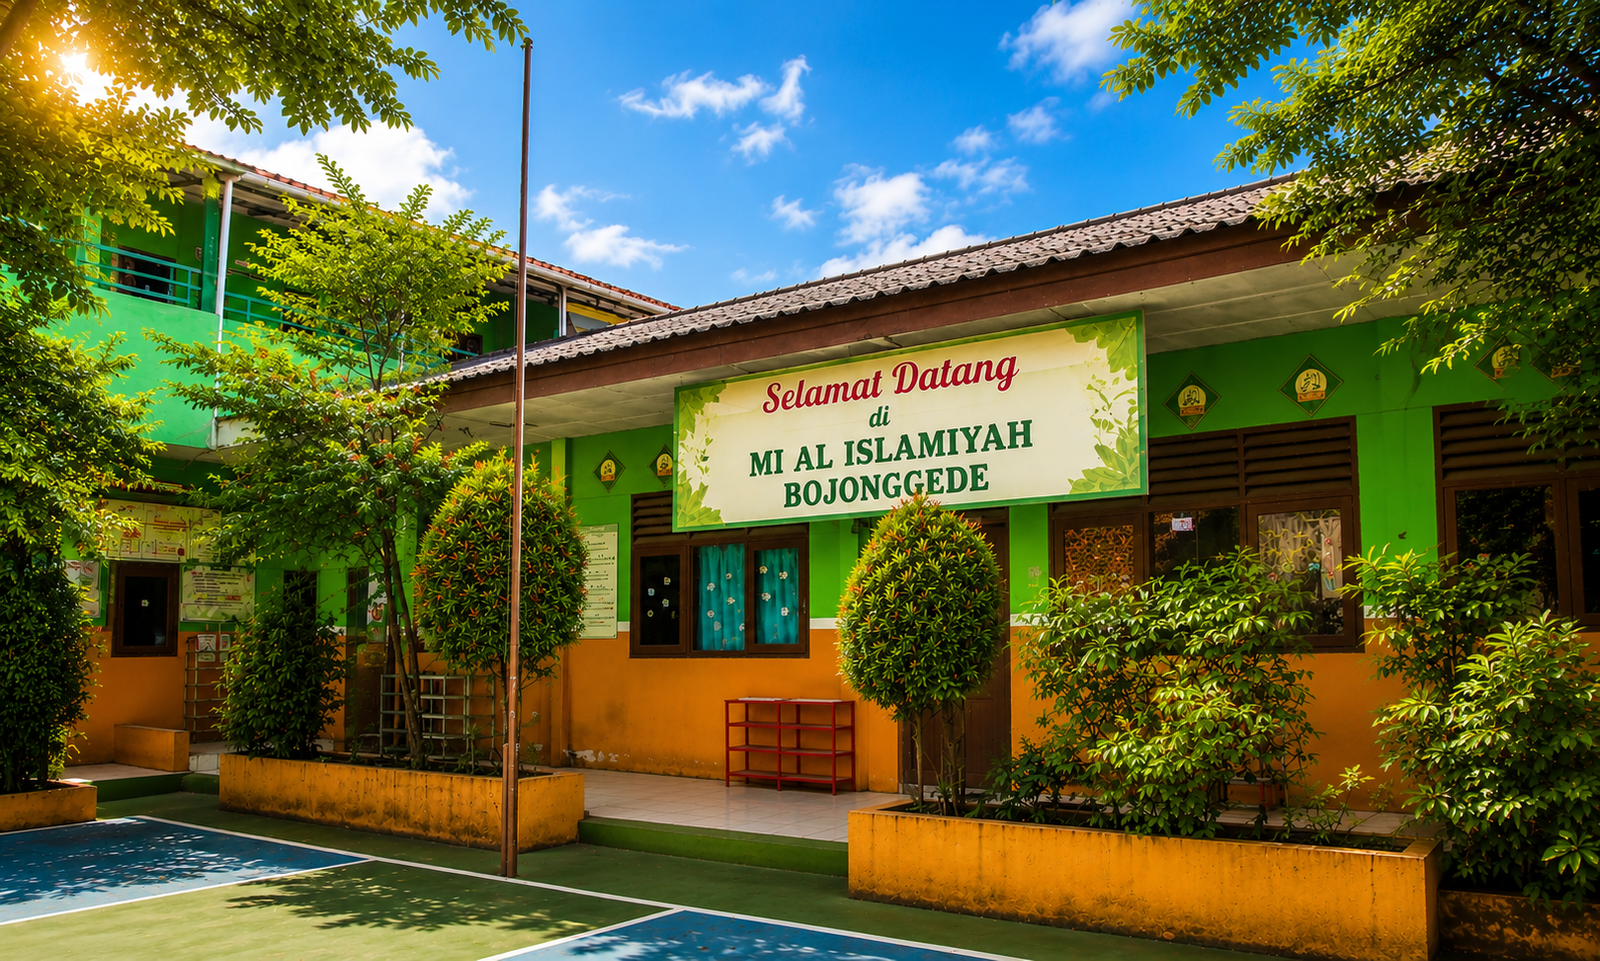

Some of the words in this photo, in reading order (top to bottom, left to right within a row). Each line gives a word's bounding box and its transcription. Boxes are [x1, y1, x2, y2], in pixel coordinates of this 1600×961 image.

[763, 370, 882, 413] Selamat
[892, 356, 1020, 394] Datang
[869, 405, 890, 428] di
[750, 449, 784, 477] MI
[794, 444, 833, 472] AL
[844, 419, 1033, 467] ISLAMIYAH
[784, 463, 989, 508] BOJONGGEDE
